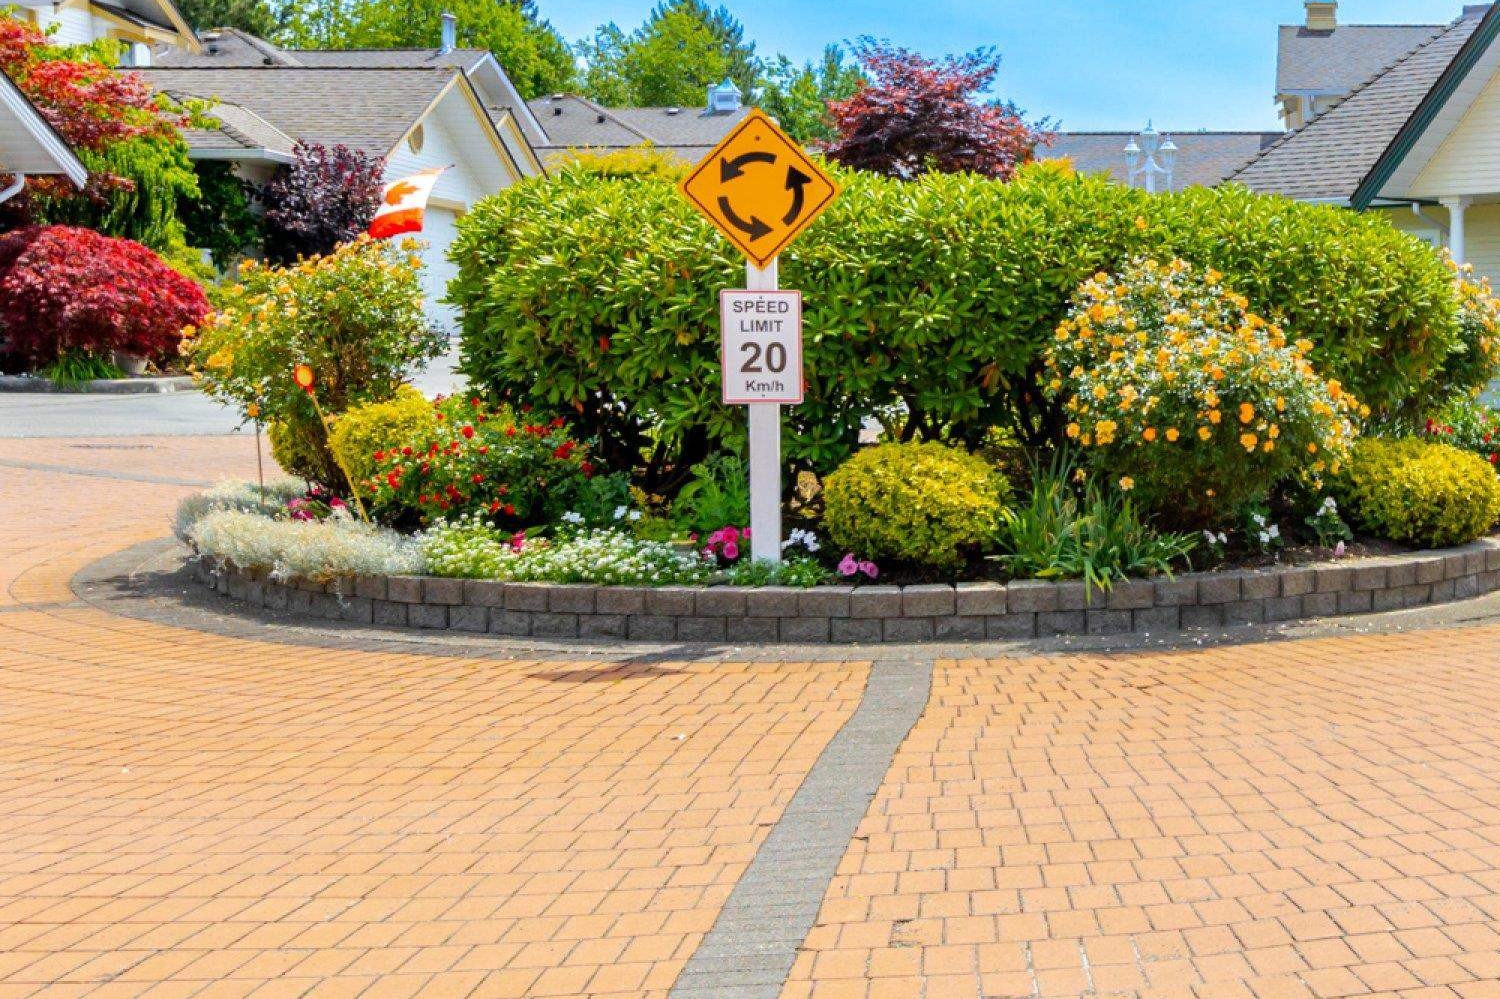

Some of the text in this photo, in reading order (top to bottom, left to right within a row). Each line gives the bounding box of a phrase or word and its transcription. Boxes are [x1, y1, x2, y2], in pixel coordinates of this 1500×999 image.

[733, 300, 789, 313] SPEED
[740, 320, 783, 332] LIMIT
[740, 341, 787, 373] 20
[746, 380, 784, 392] Km/h
